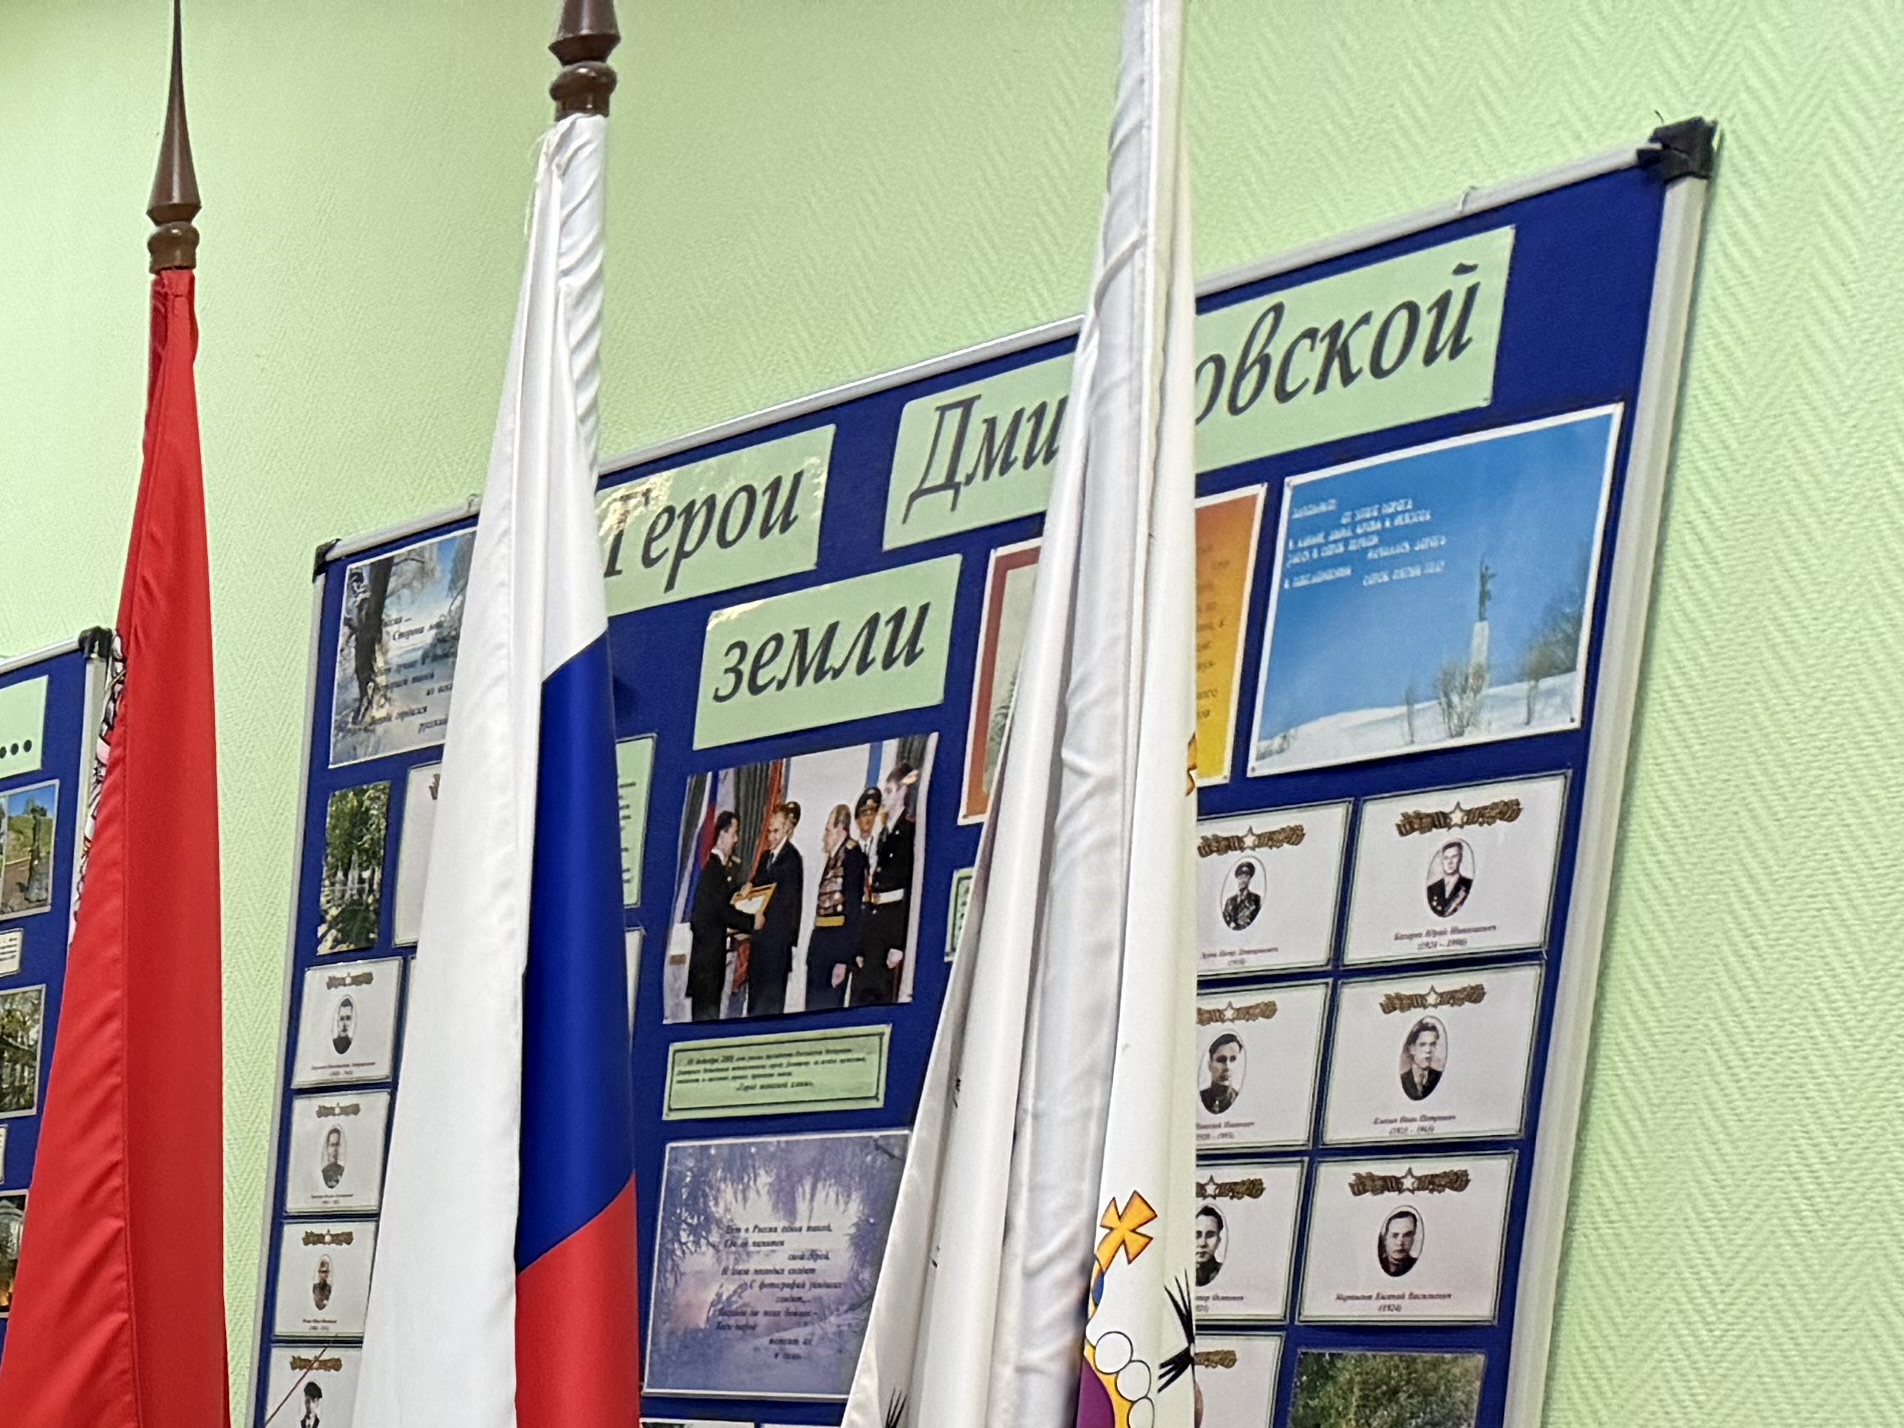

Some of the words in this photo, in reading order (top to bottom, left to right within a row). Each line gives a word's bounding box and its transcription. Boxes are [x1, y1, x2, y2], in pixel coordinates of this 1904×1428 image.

[901, 263, 1484, 524] Дмиовской
[602, 462, 801, 594] Герои
[713, 588, 930, 704] земли
